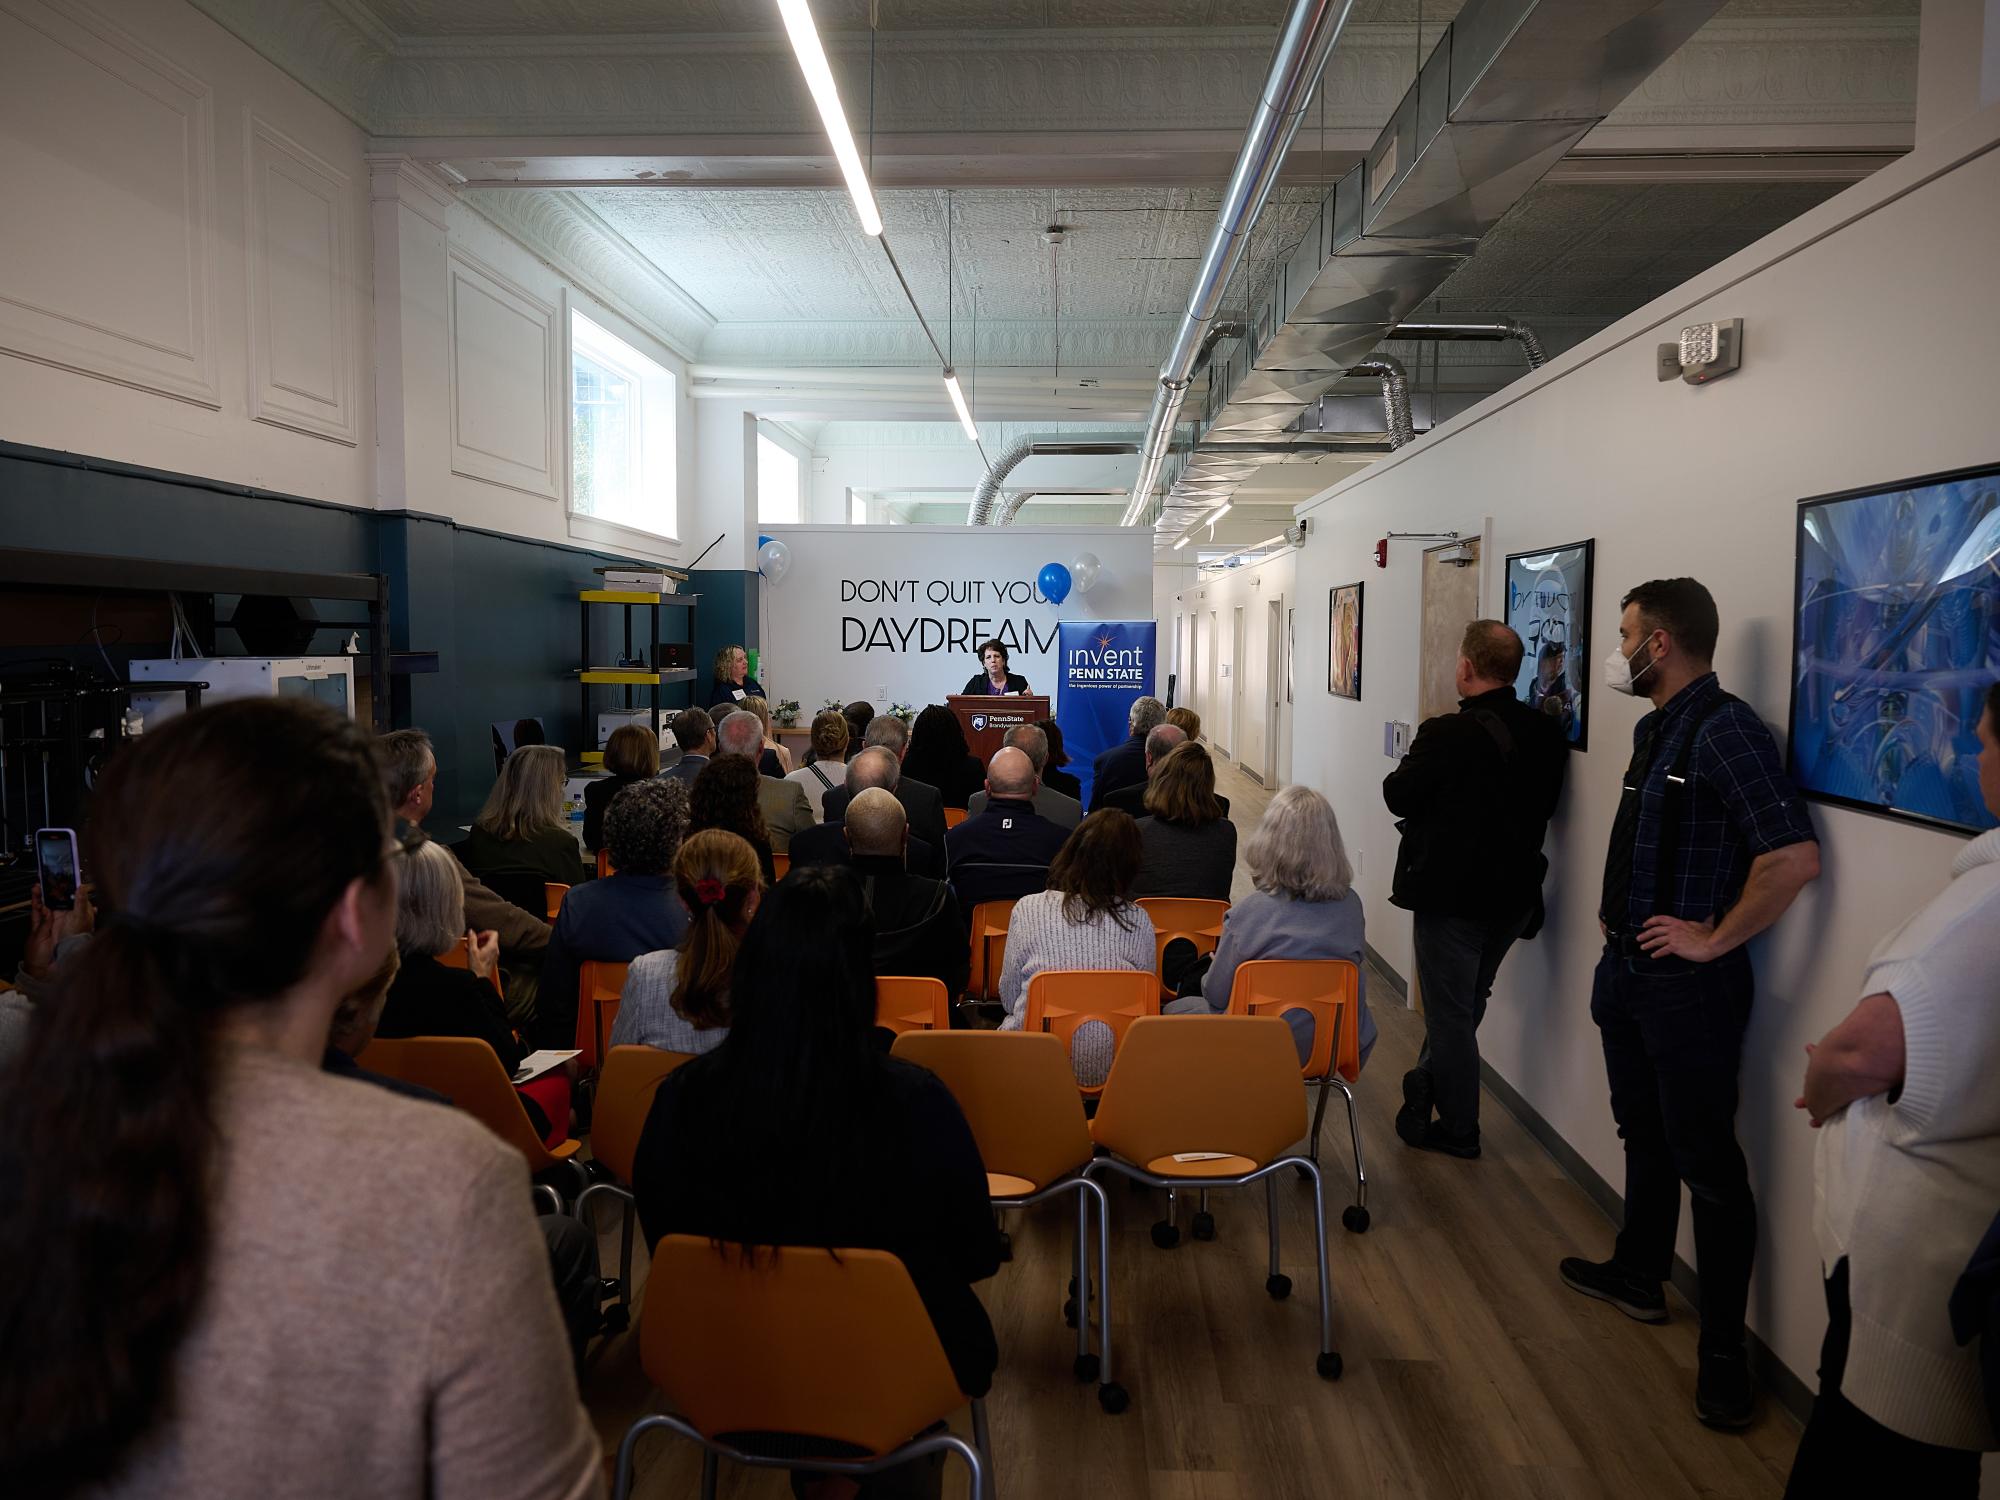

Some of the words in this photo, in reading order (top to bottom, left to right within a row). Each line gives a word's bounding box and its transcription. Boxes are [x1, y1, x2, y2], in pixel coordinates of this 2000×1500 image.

[841, 579, 919, 603] DON'T
[926, 580, 986, 606] QUIT
[991, 581, 1048, 604] YOU
[842, 616, 1060, 654] DAYDREAM
[1069, 645, 1143, 666] invent
[1068, 668, 1104, 679] PENN
[1106, 668, 1143, 680] STATE
[1002, 818, 1012, 829] FJ
